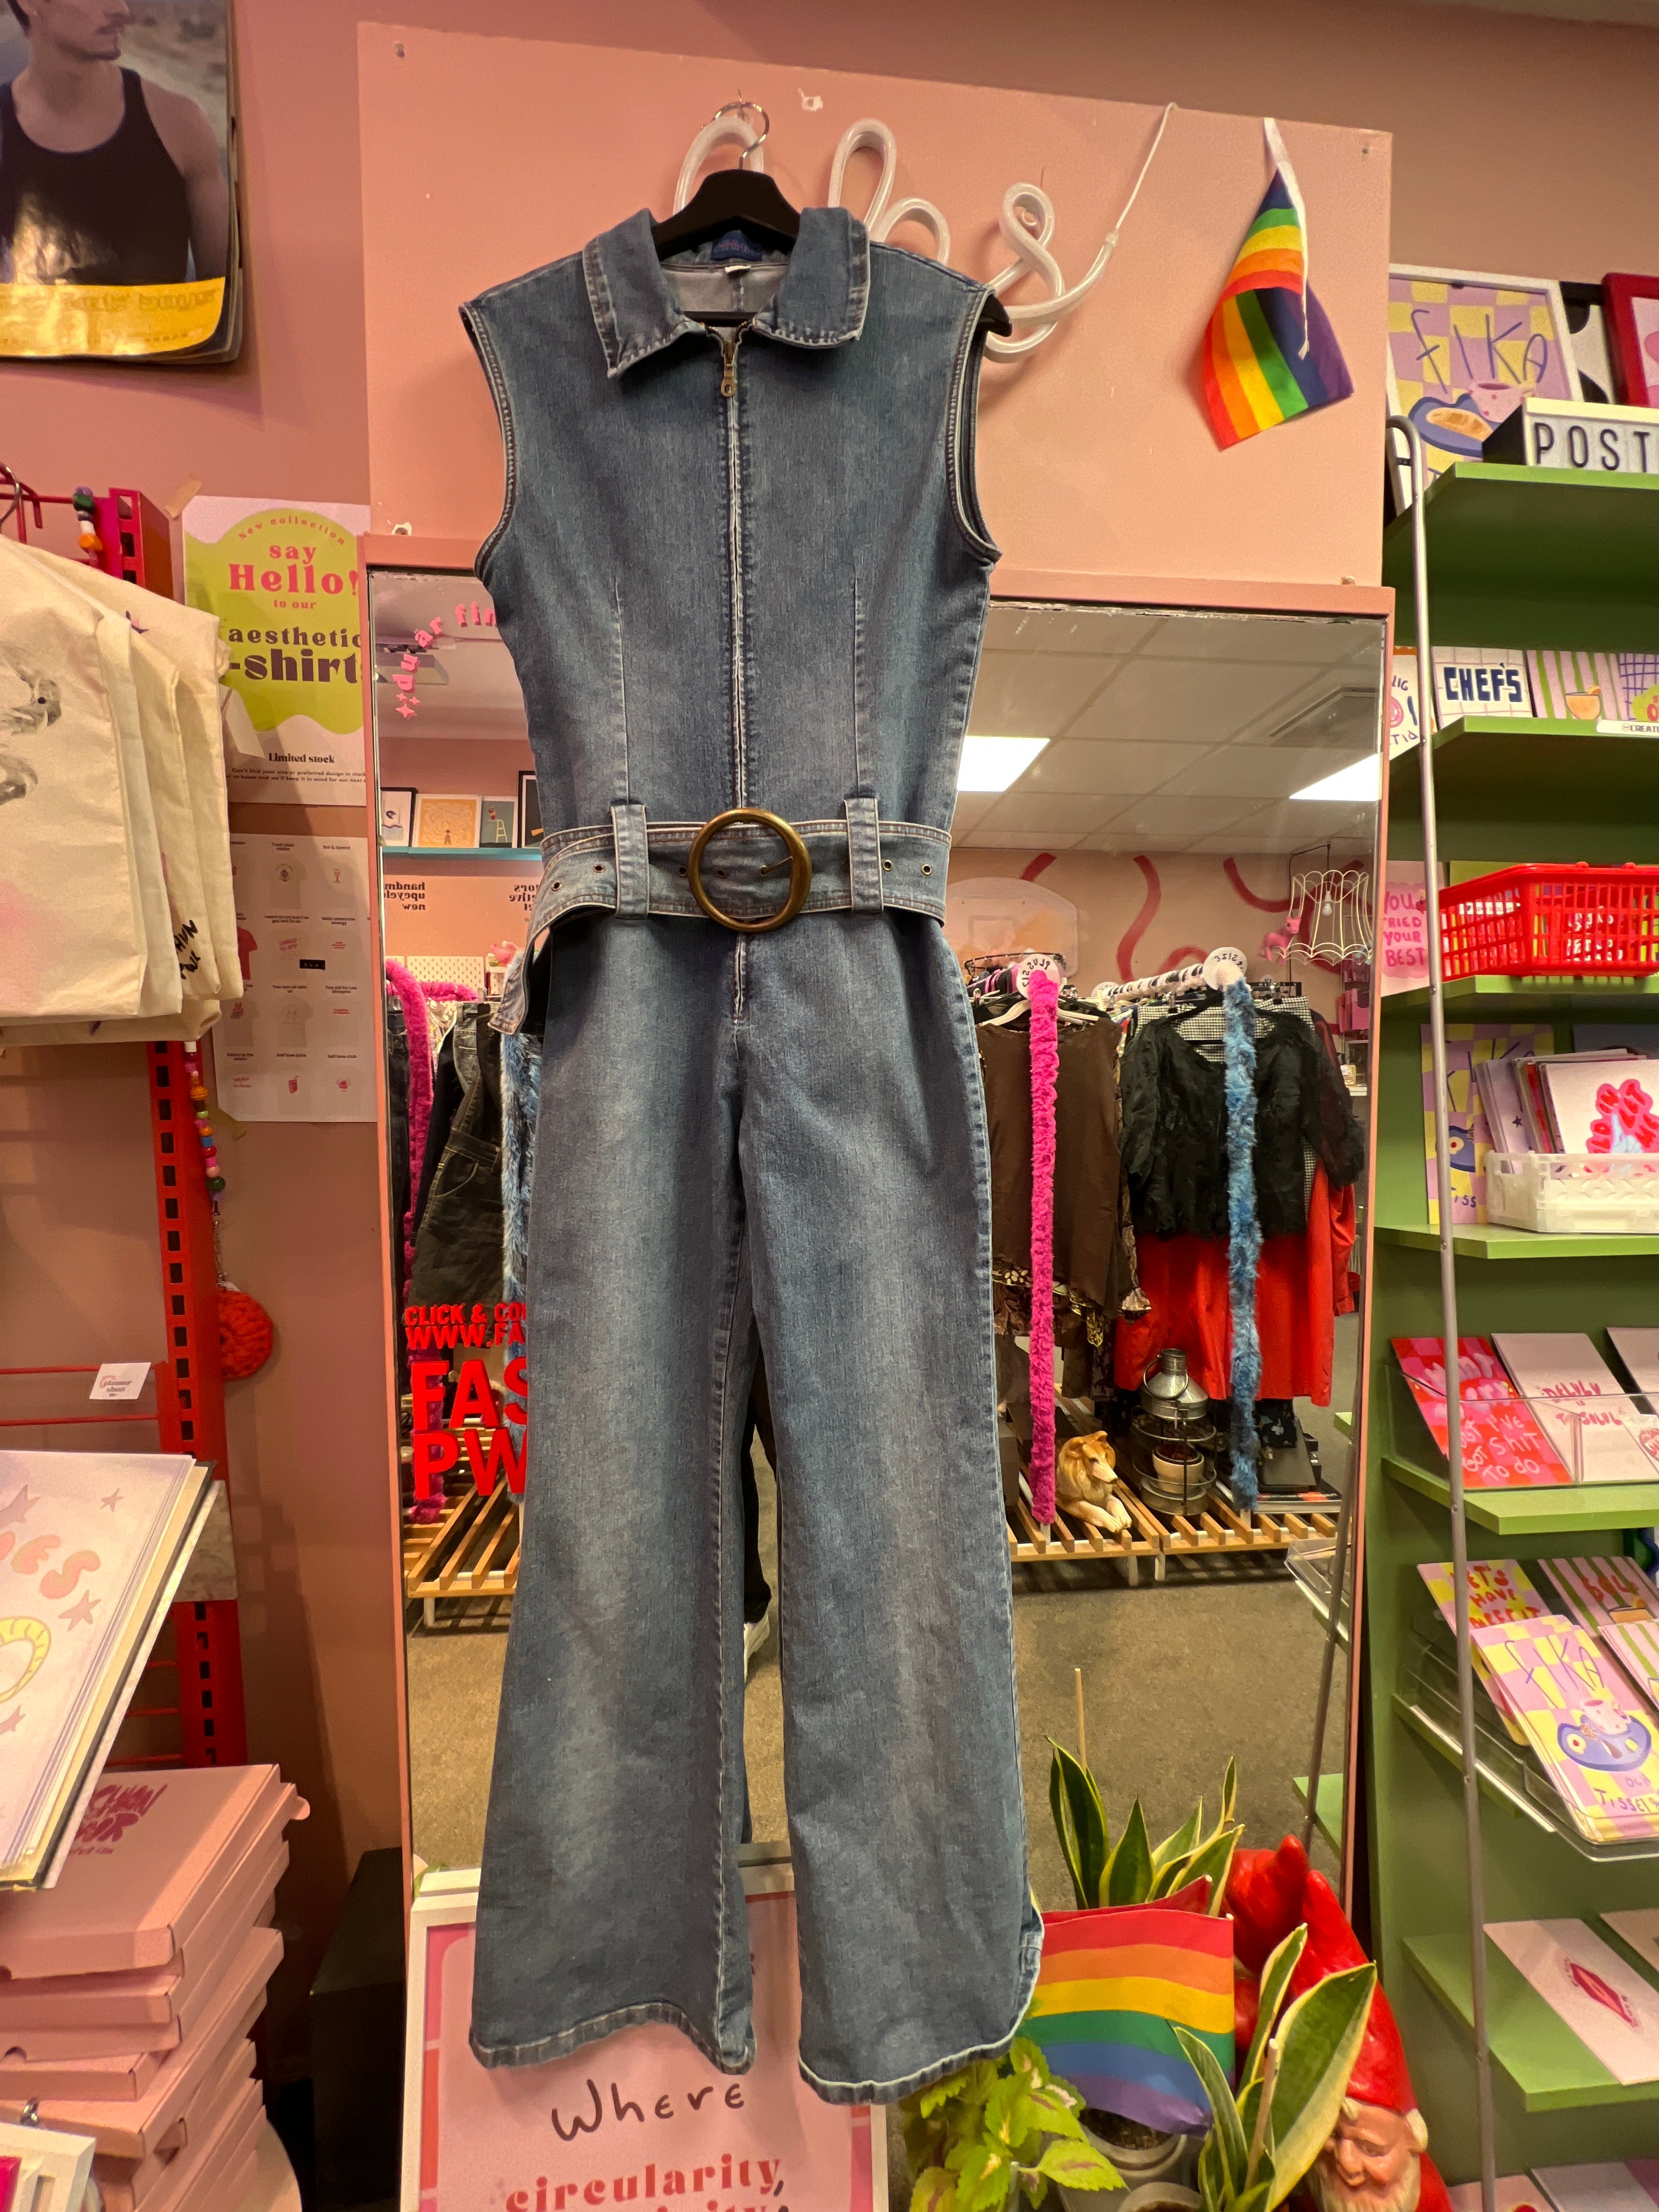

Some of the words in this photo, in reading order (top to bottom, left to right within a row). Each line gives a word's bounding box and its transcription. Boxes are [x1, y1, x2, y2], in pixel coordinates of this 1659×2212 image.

[1534, 421, 1651, 473] POST
[270, 516, 345, 545] collection
[269, 545, 317, 565] say
[229, 563, 359, 596] Hello!
[274, 599, 287, 608] to
[228, 626, 360, 648] aesthetic
[229, 648, 363, 684] -shirt
[1443, 662, 1523, 703] CHEF'S
[269, 753, 307, 763] Limited
[308, 755, 335, 764] stock
[1383, 930, 1422, 946] YOUR
[1385, 947, 1425, 967] BEST
[404, 1302, 466, 1325] CLICK
[471, 1302, 488, 1323] &
[103, 1379, 133, 1388] planner
[1450, 1565, 1509, 1589] ET'S
[551, 2079, 744, 2141] Where
